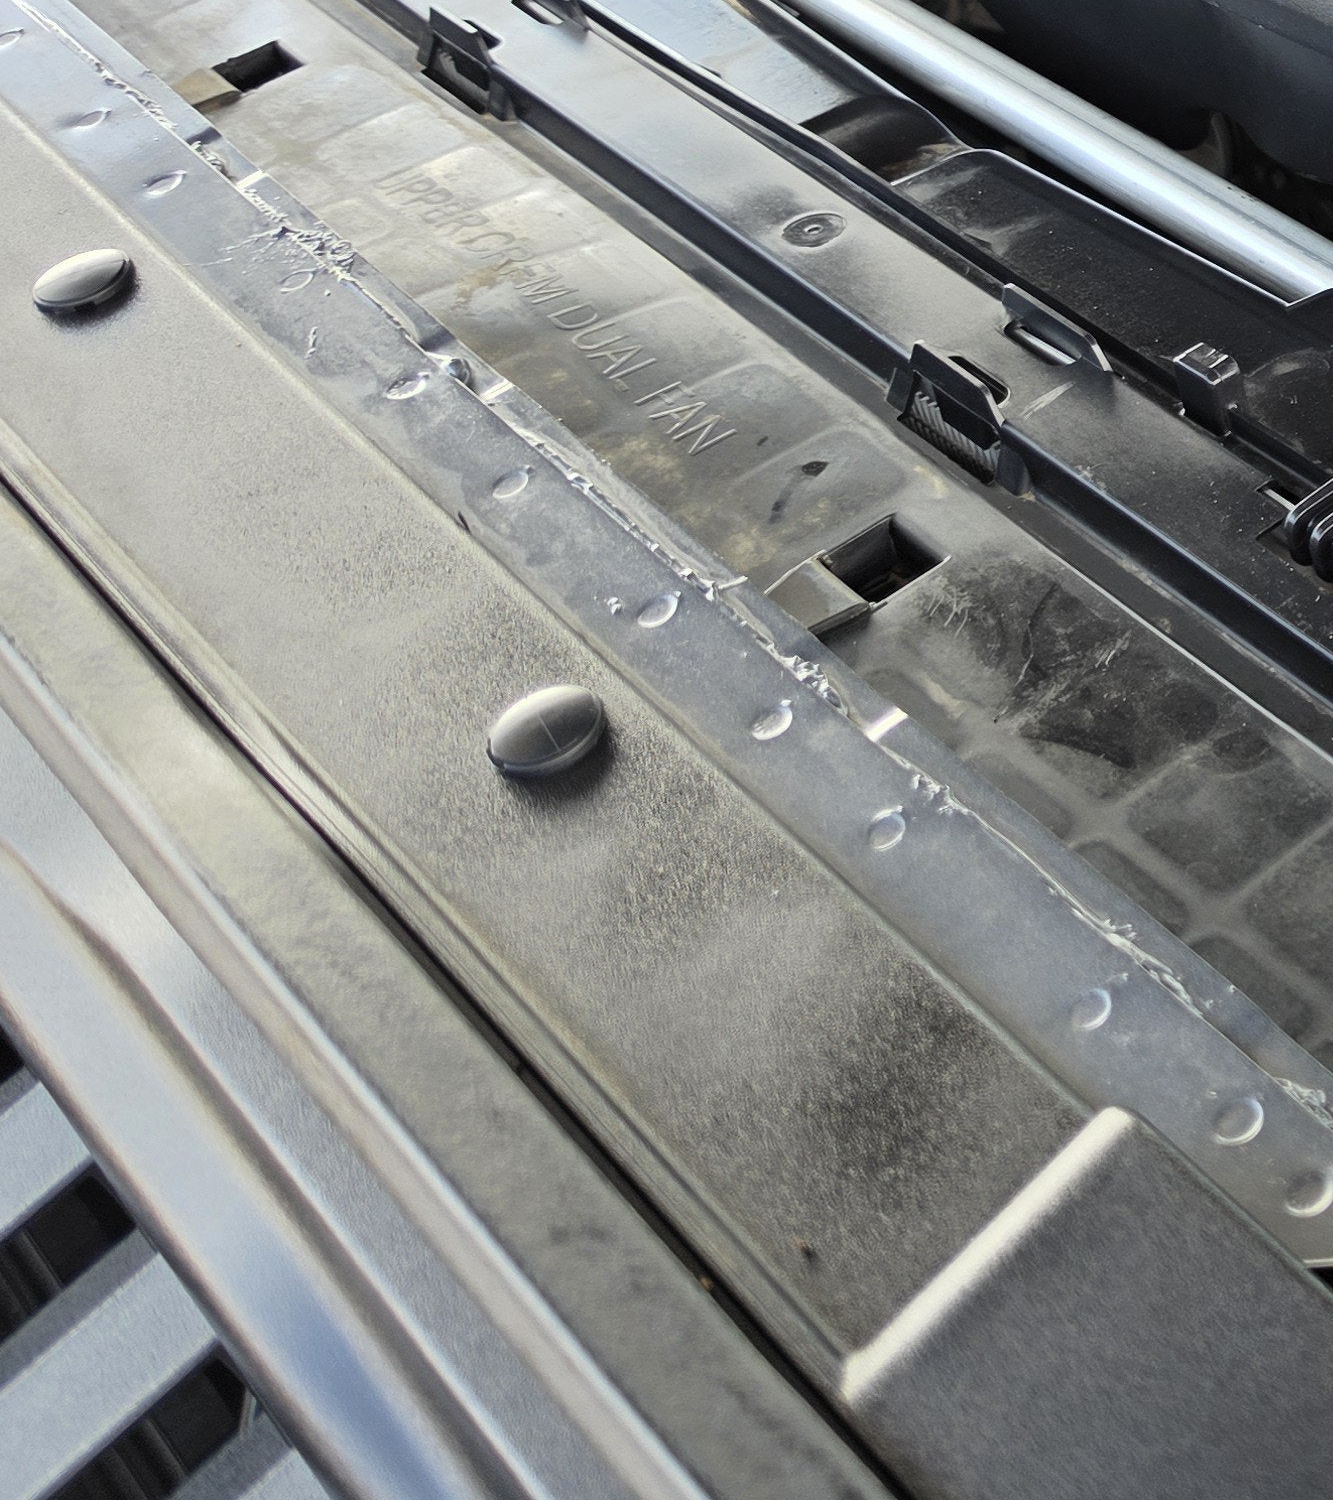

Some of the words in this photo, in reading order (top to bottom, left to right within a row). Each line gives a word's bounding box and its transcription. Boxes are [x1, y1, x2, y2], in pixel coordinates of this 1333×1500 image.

[375, 172, 490, 232] UPPER
[547, 303, 657, 392] DUAL
[634, 380, 738, 455] FAN
